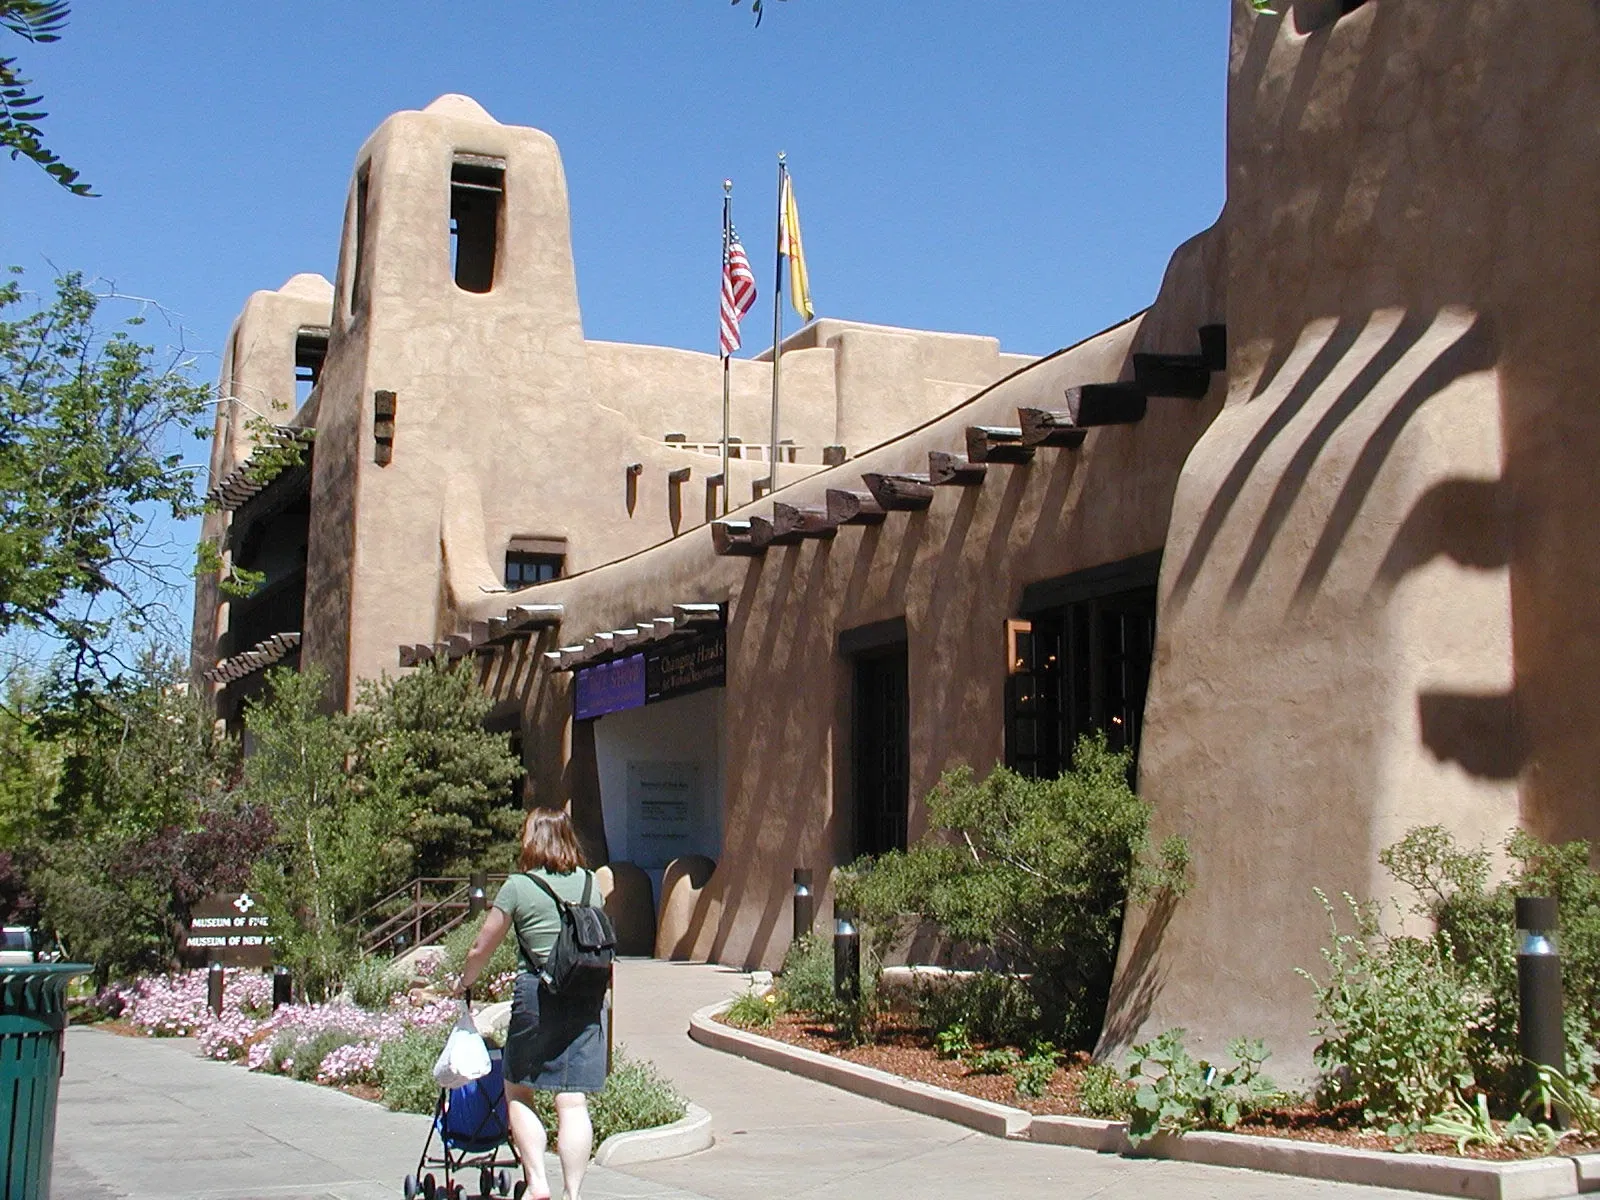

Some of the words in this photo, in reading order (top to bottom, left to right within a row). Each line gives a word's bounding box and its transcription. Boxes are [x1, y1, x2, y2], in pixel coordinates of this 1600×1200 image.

[191, 917, 232, 928] MUSEUM
[233, 917, 246, 927] OF
[186, 936, 226, 947] MUSEUM
[228, 936, 241, 946] OF
[242, 936, 263, 945] NEW
